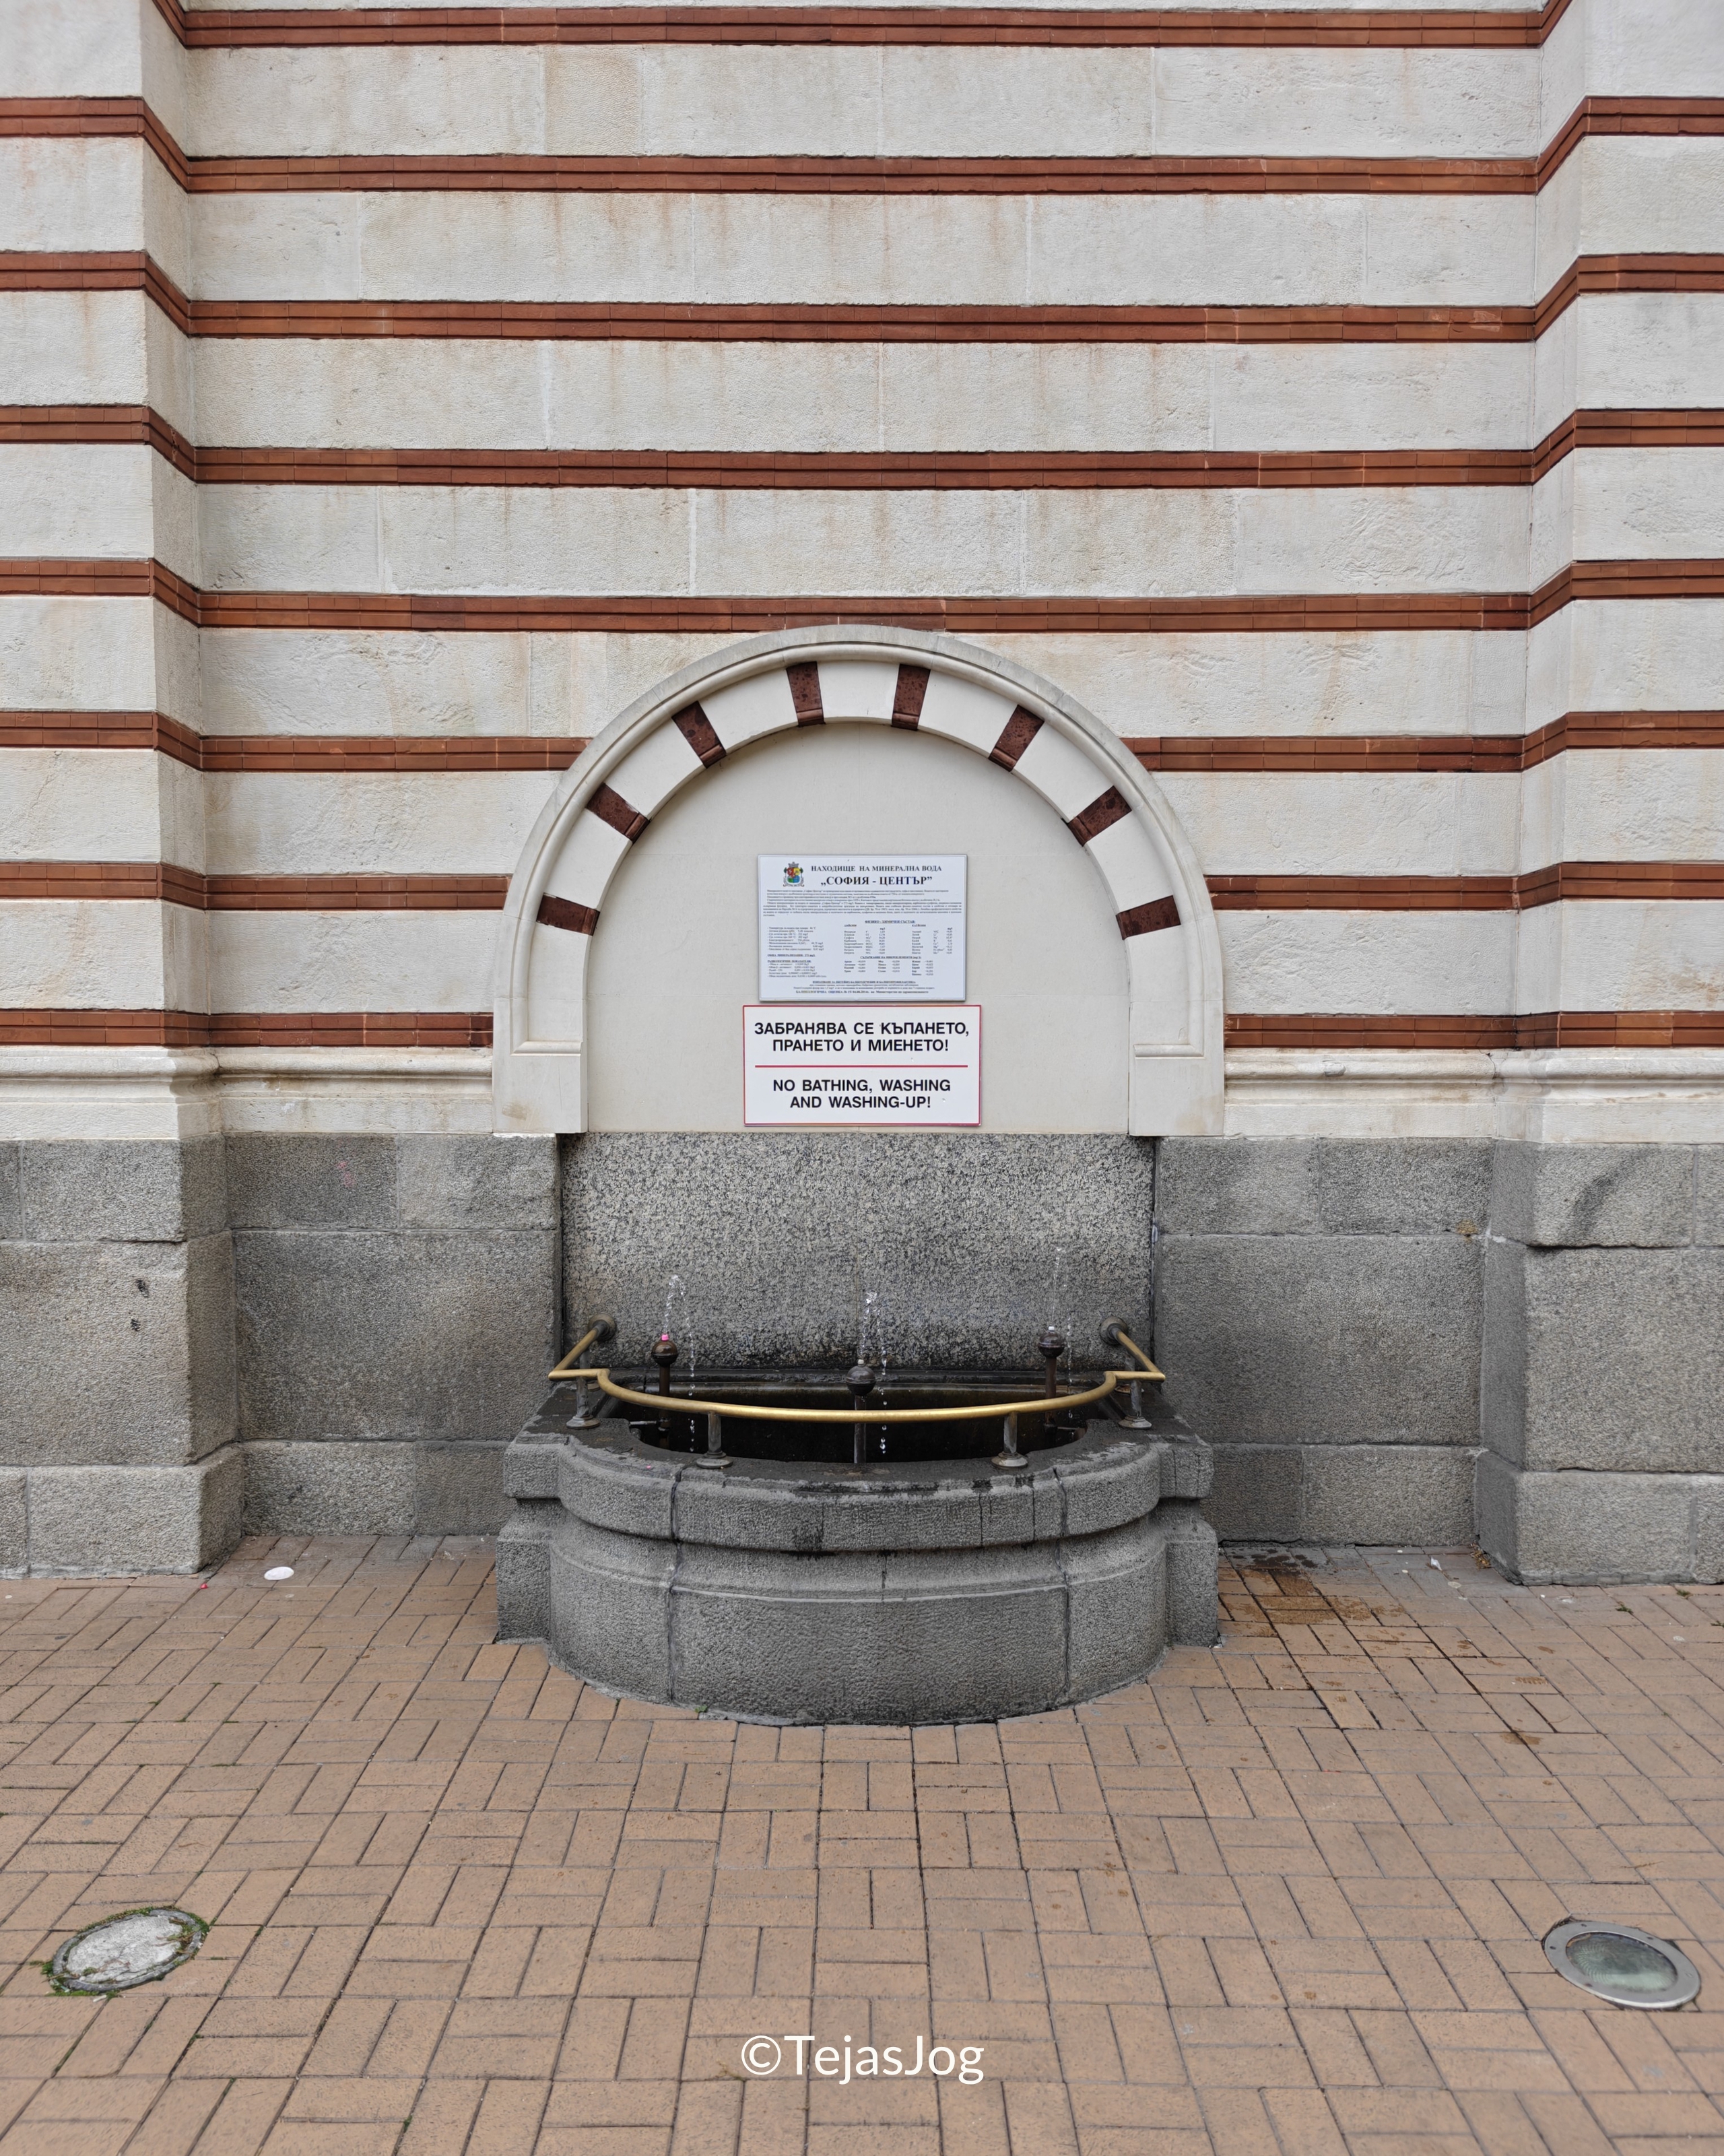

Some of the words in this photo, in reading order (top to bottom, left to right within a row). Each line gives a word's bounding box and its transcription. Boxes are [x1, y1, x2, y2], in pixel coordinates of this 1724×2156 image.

[754, 1022, 847, 1035] ЗАБРАНЯВА
[853, 1022, 874, 1035] СЕ
[881, 1022, 969, 1037] КЪПАНЕТО,
[772, 1039, 844, 1051] ПРАНЕТО
[851, 1039, 861, 1051] И
[868, 1039, 948, 1051] МИЕНЕТО!
[773, 1079, 795, 1092] NO
[802, 1079, 873, 1094] BATHING,
[879, 1079, 951, 1092] WASHING
[790, 1096, 822, 1108] AND
[828, 1096, 931, 1109] WASHING-UP!
